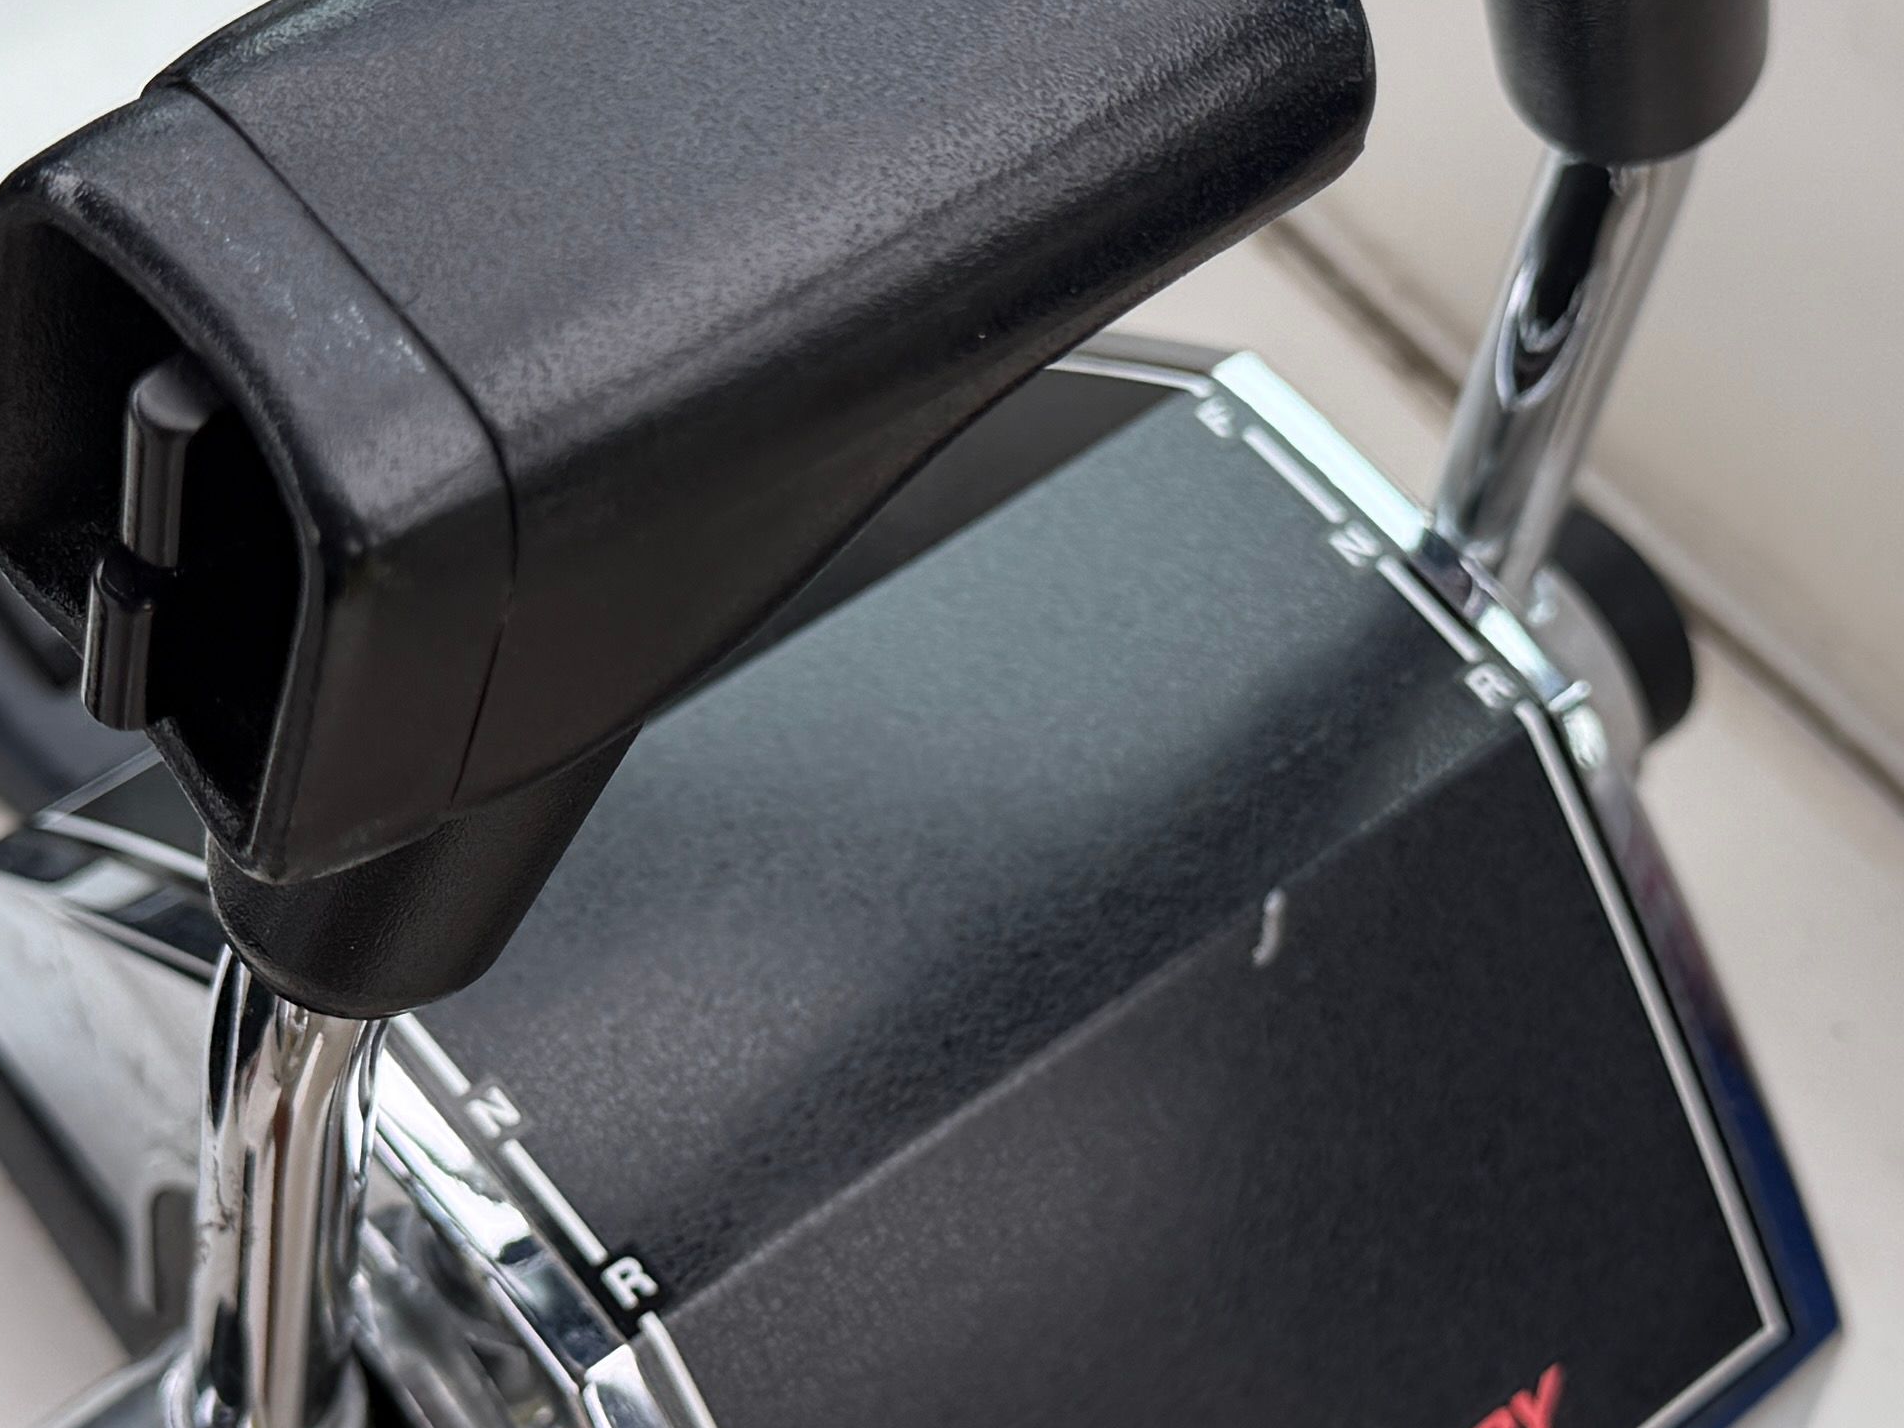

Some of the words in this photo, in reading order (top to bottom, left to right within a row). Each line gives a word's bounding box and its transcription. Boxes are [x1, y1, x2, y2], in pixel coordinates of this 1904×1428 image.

[1329, 523, 1383, 569] N
[1464, 662, 1519, 711] R
[463, 1083, 523, 1139] N
[600, 1255, 660, 1310] R
